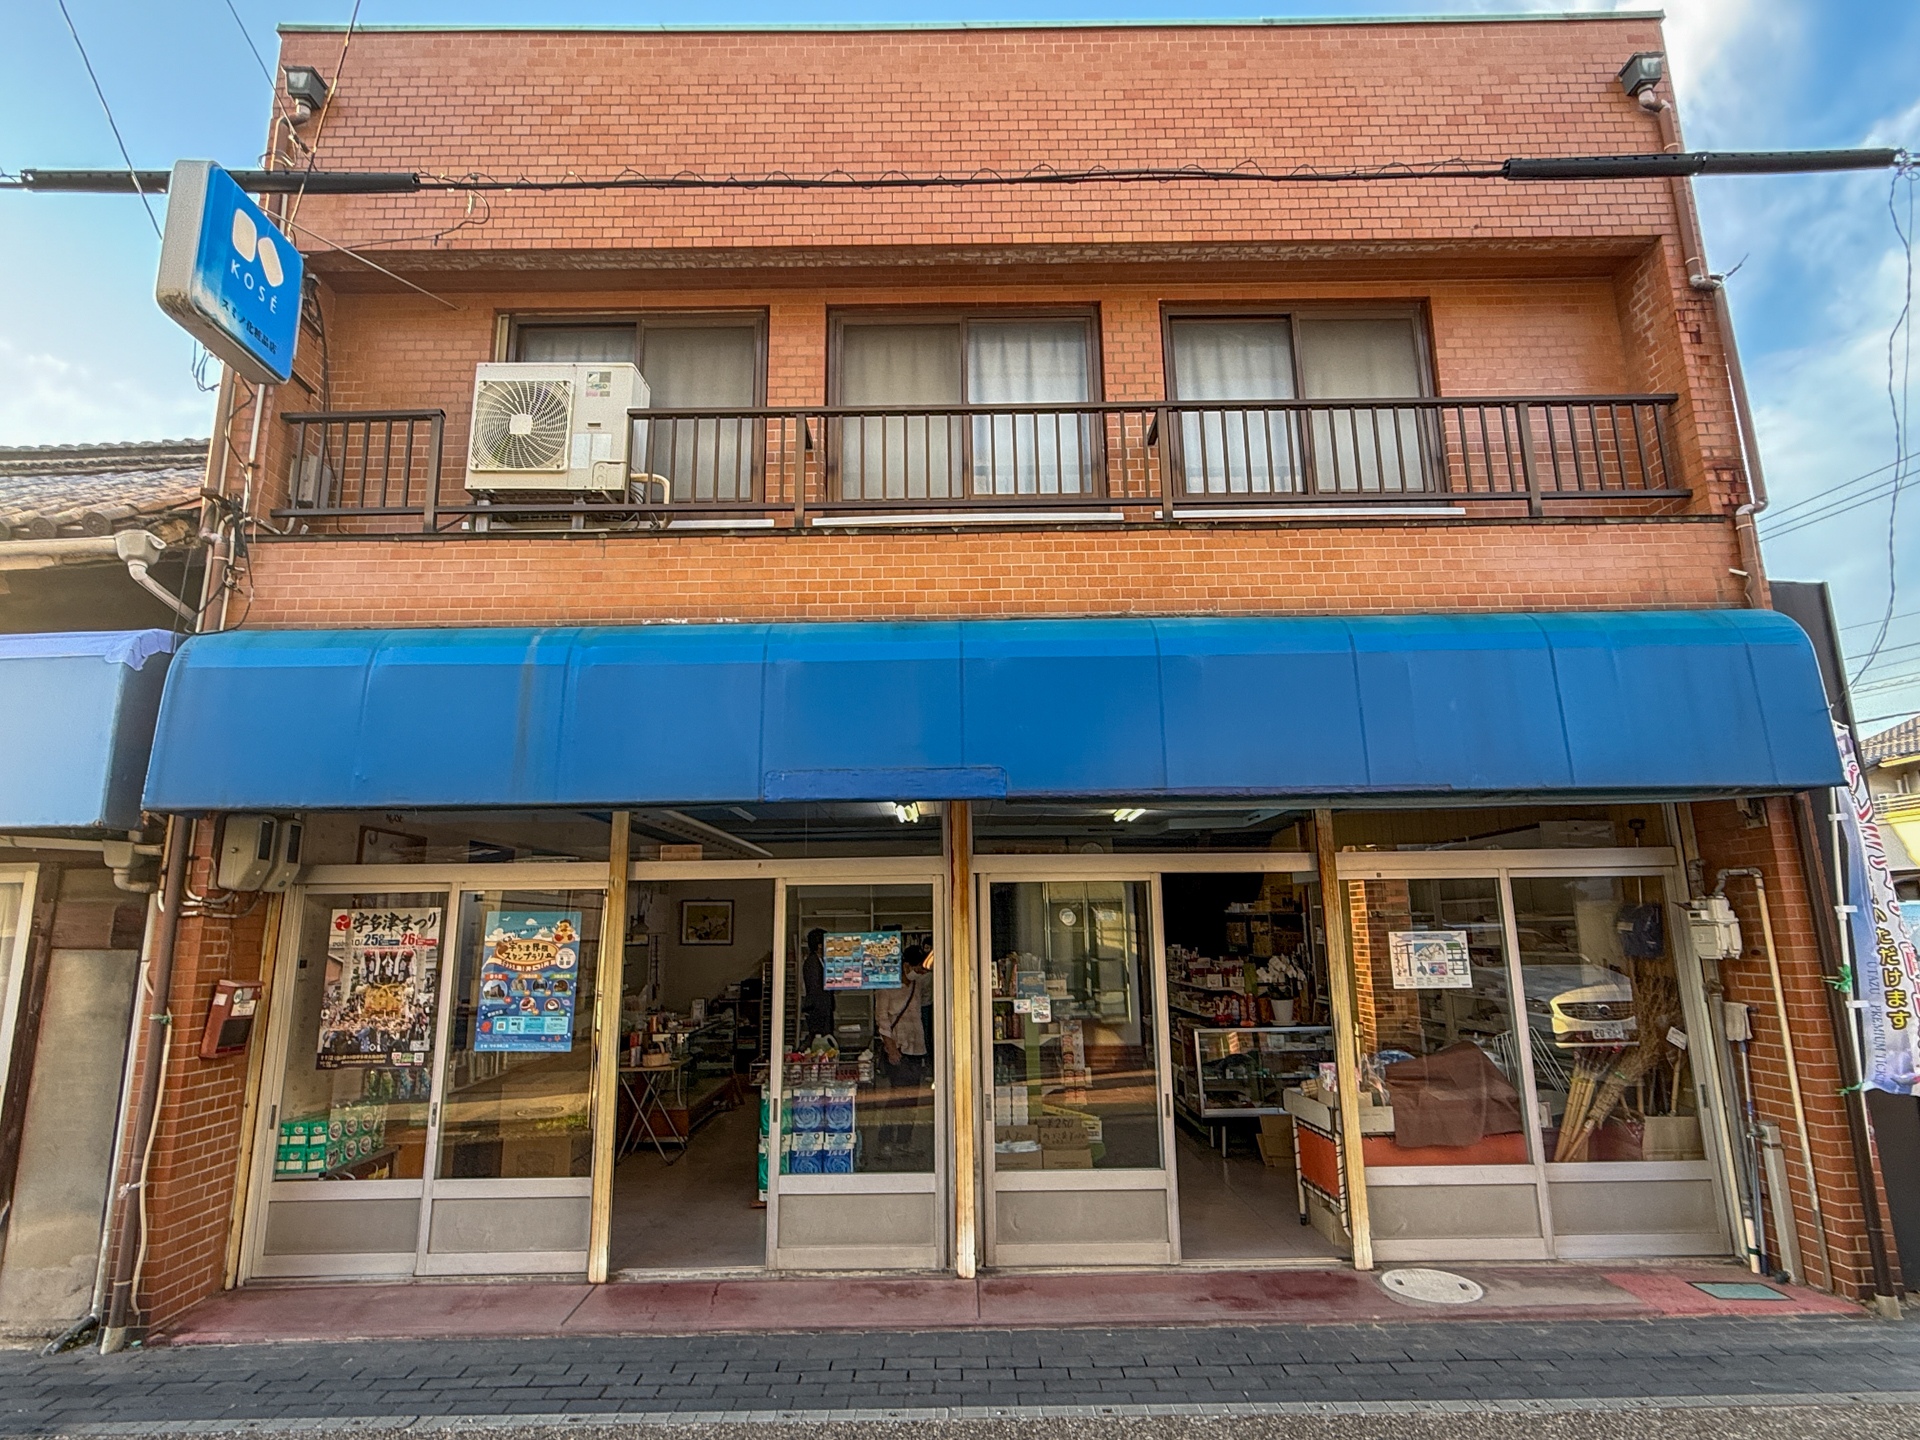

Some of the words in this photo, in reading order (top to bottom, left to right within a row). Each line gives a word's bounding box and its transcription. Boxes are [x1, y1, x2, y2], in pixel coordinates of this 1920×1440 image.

[231, 258, 278, 314] KOSÉ
[352, 911, 437, 934] 宇多津まつり
